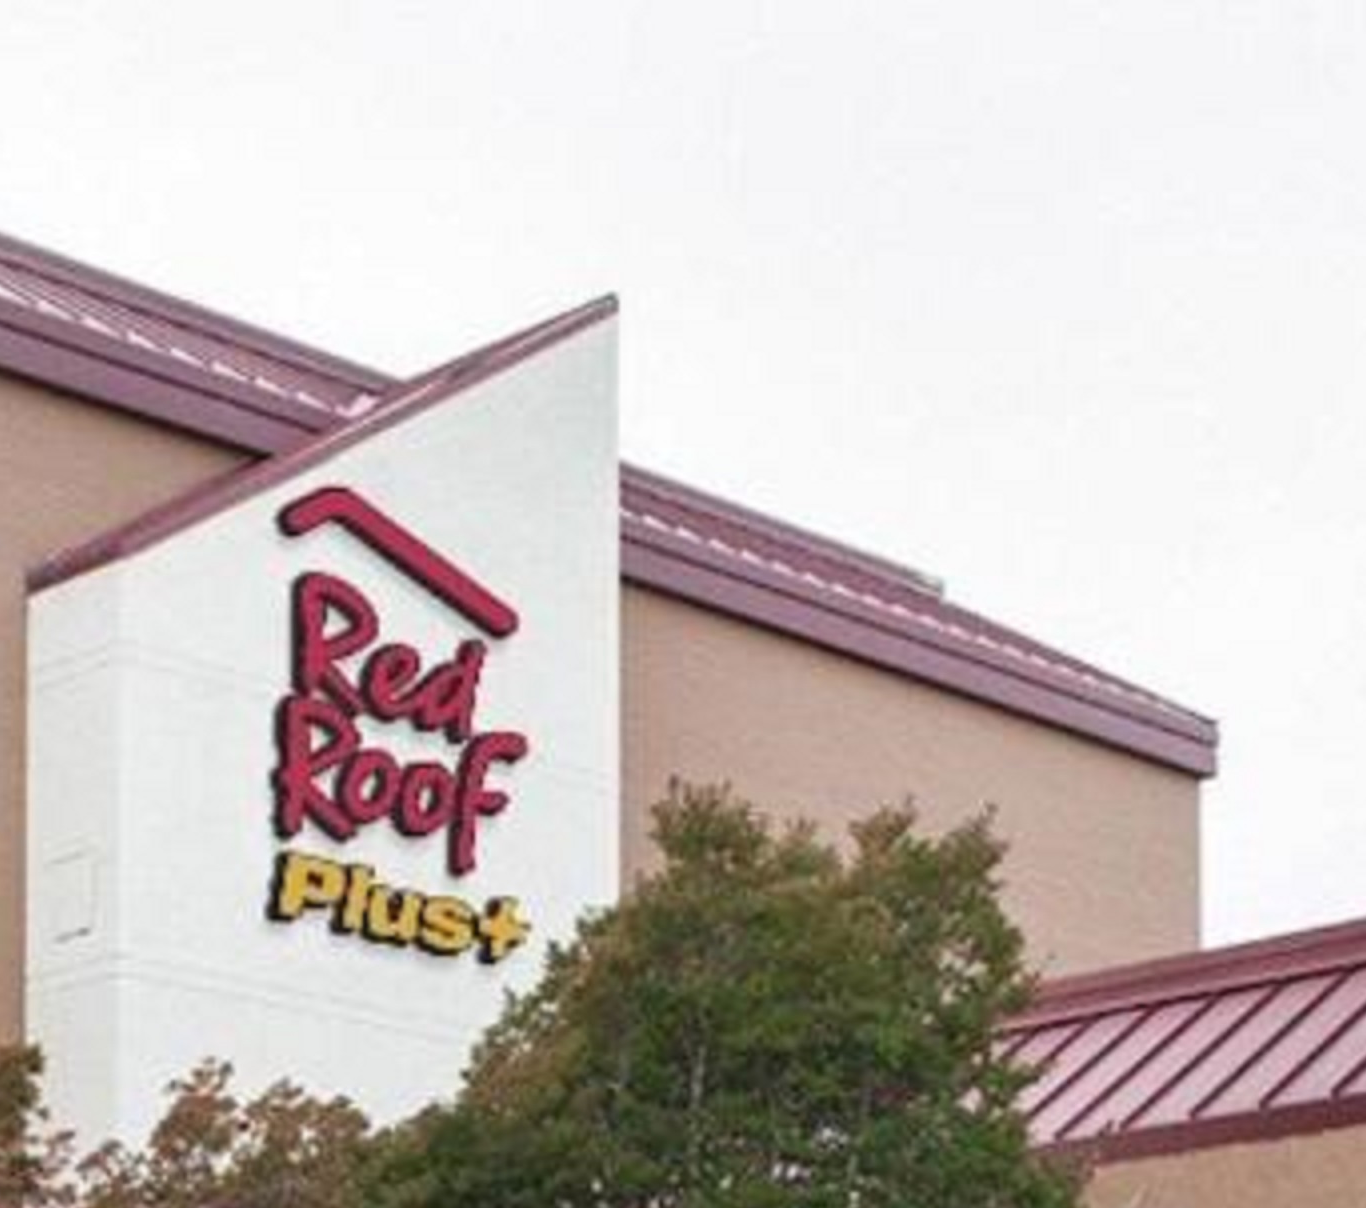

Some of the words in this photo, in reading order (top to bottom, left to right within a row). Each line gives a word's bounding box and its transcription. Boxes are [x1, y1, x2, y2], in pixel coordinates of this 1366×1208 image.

[292, 573, 486, 741] Red
[273, 694, 527, 876] Roof
[268, 851, 530, 962] Plus+
